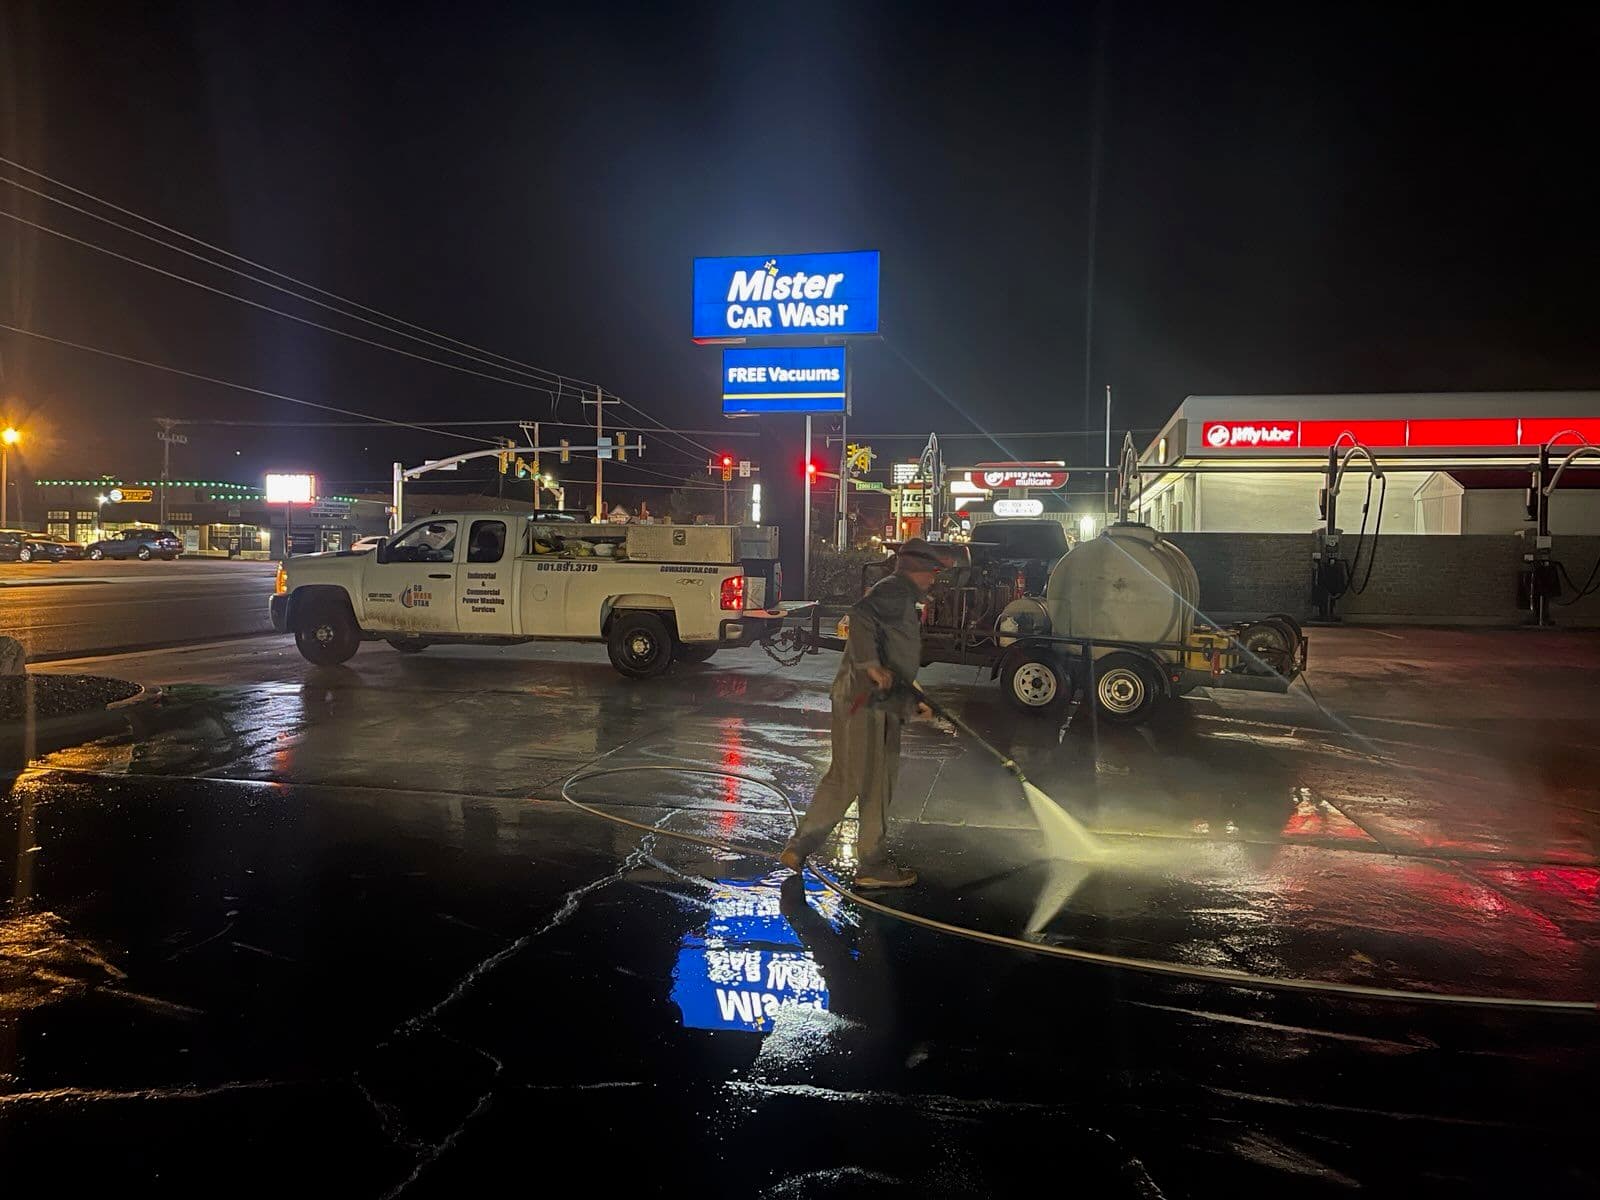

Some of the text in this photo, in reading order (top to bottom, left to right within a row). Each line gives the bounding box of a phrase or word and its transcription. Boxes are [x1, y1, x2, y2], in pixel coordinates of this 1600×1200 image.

[727, 268, 844, 302] Mister
[726, 302, 846, 329] CAR WASH
[728, 366, 841, 383] FREE Vacuums
[467, 572, 497, 580] Industrial
[466, 588, 500, 596] Commercial
[462, 597, 480, 605] Power
